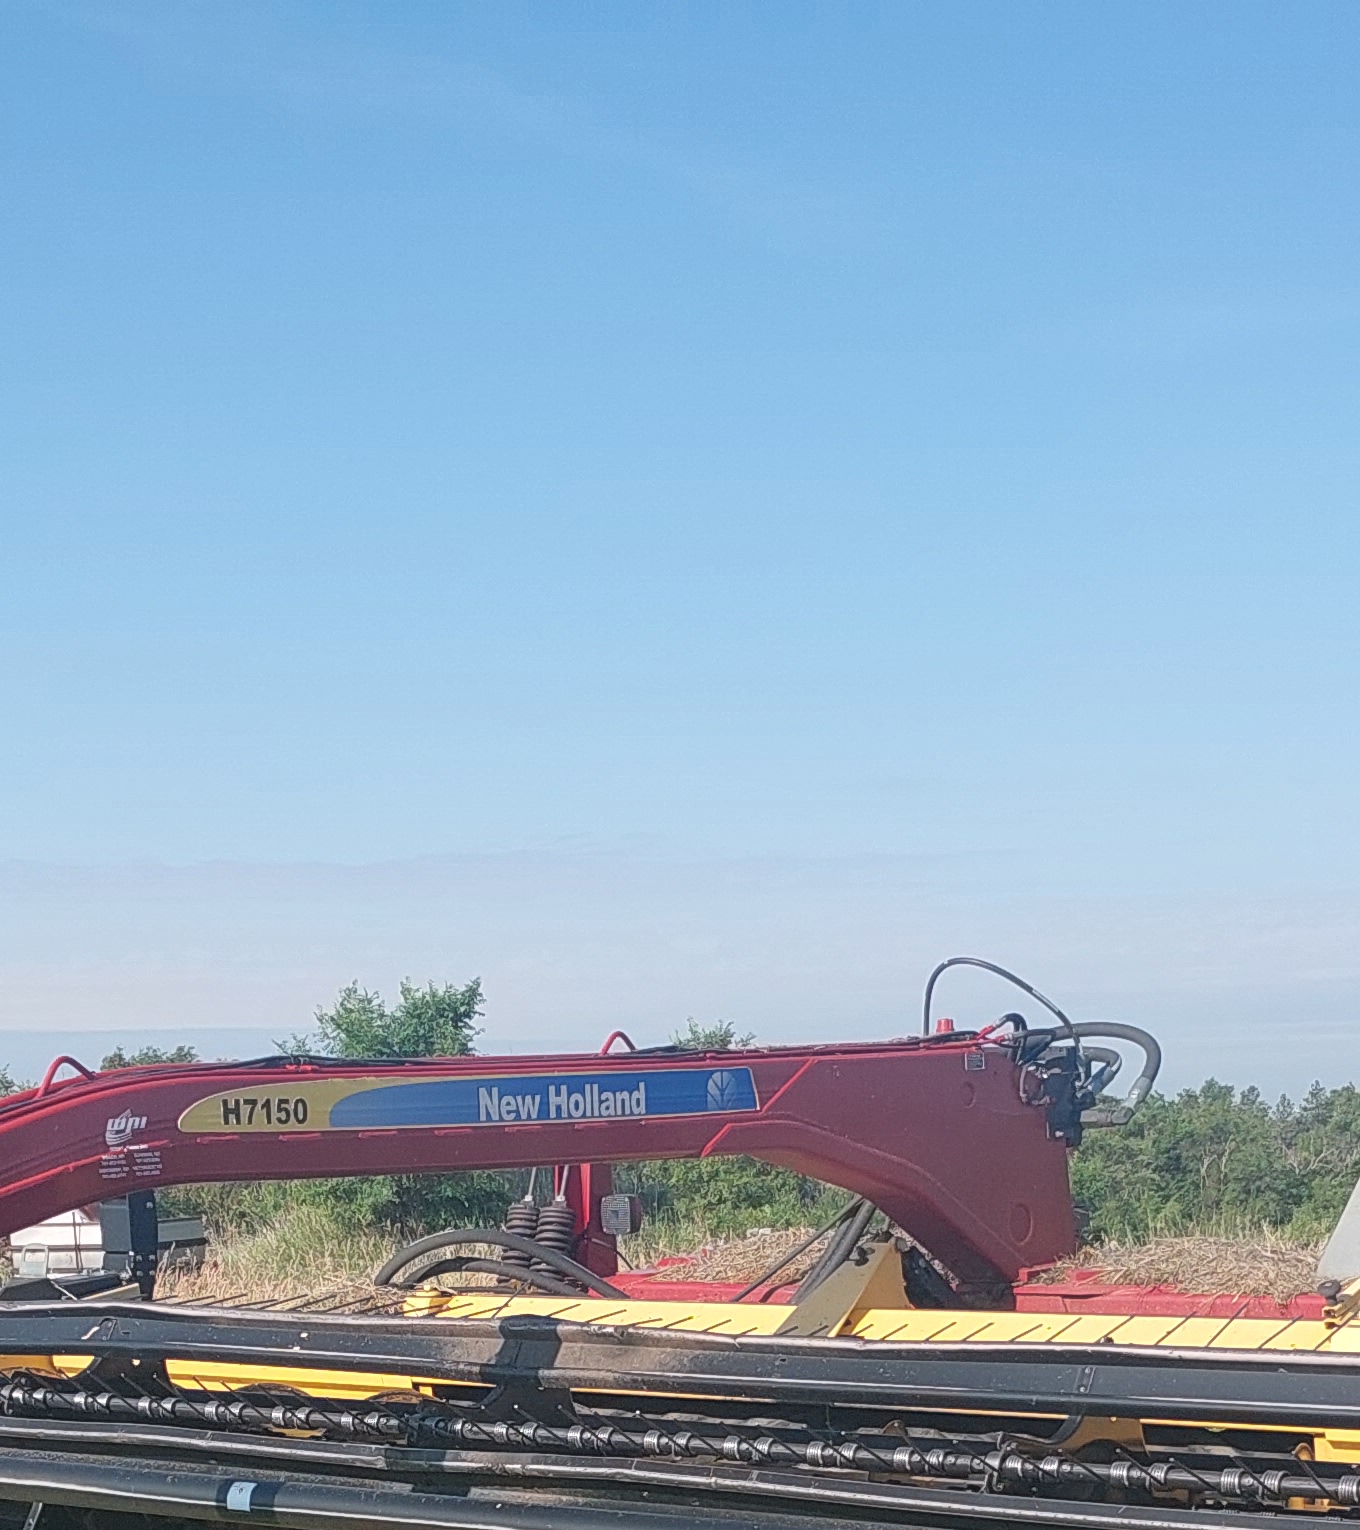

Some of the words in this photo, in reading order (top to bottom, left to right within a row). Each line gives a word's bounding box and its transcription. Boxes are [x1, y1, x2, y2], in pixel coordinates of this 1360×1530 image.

[221, 1097, 308, 1126] H7150
[478, 1086, 541, 1122] New
[547, 1081, 647, 1119] Holland
